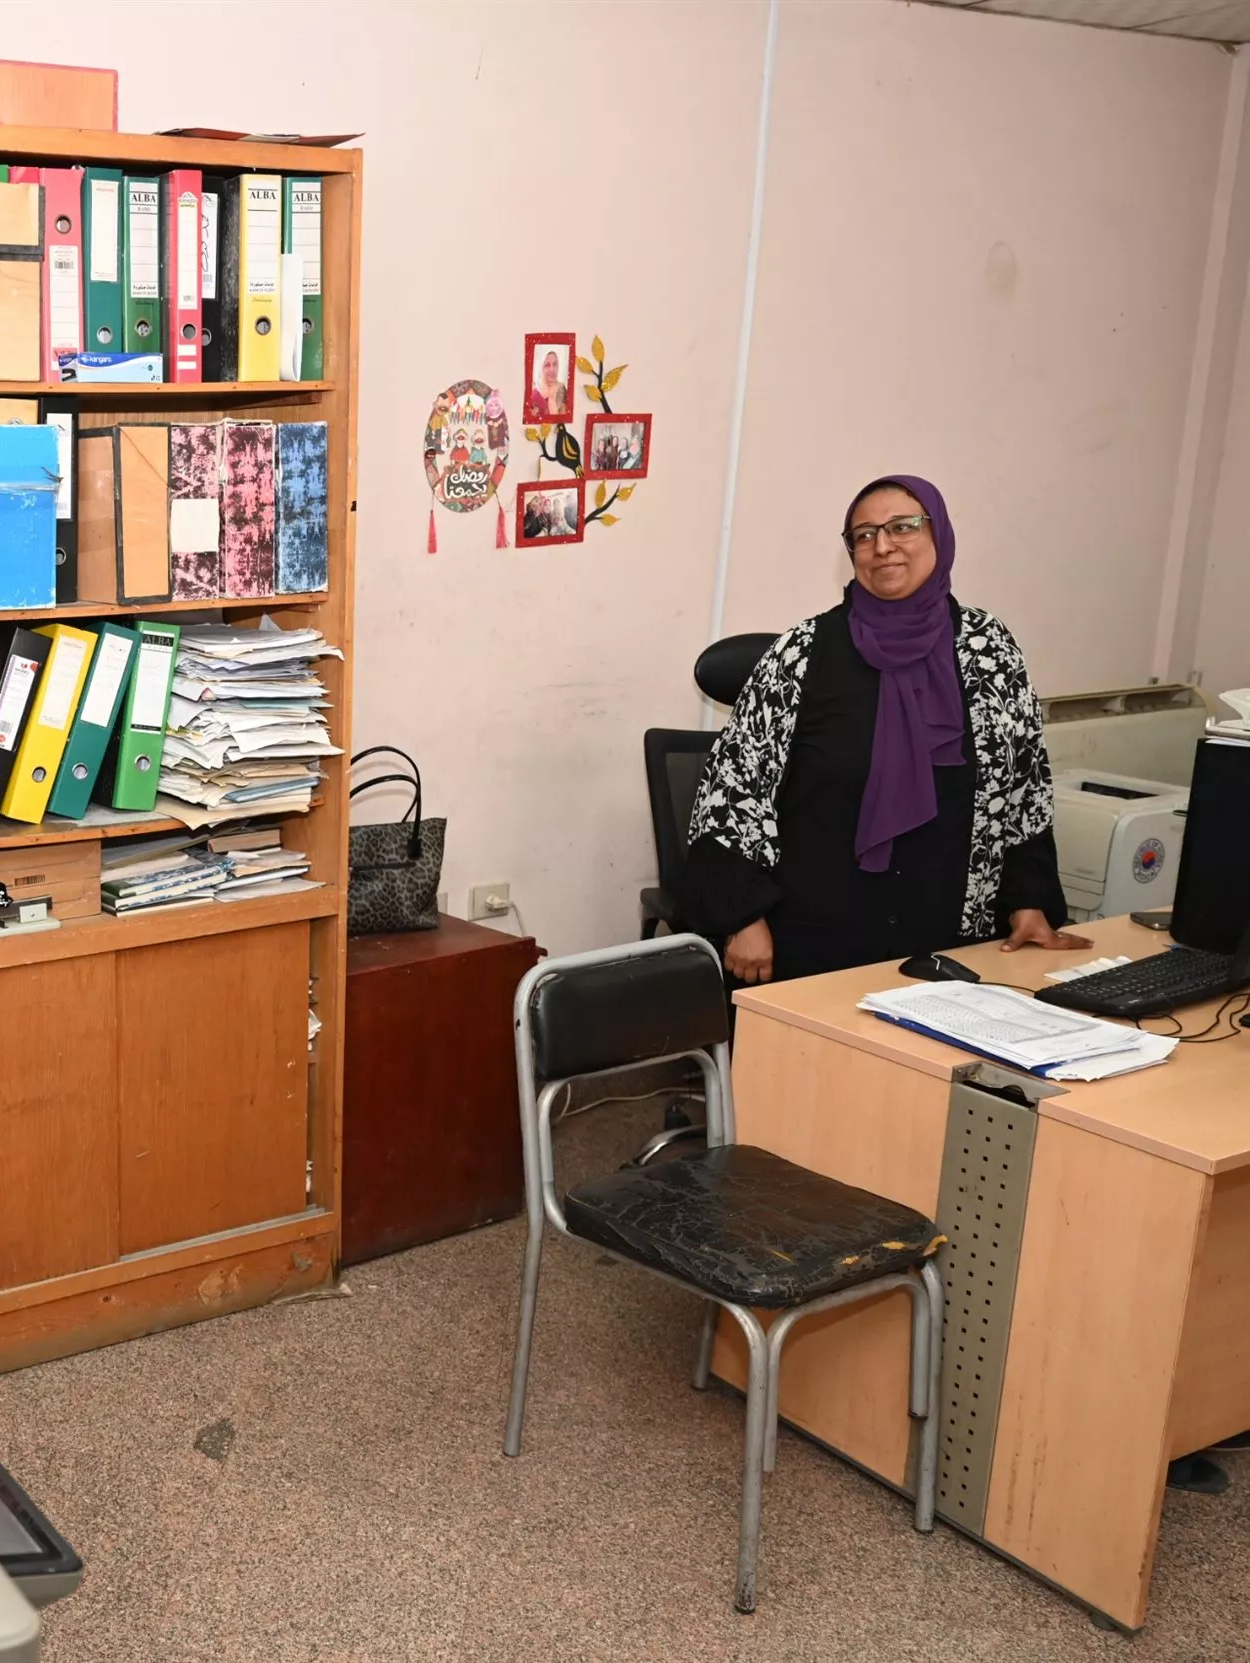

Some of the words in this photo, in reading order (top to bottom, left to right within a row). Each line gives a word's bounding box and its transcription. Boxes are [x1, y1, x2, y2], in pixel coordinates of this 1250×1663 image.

[131, 193, 156, 203] ALBA
[249, 190, 277, 200] ALBA
[293, 192, 319, 202] ALBA
[89, 355, 112, 364] kangaro
[145, 635, 171, 646] ALBA
